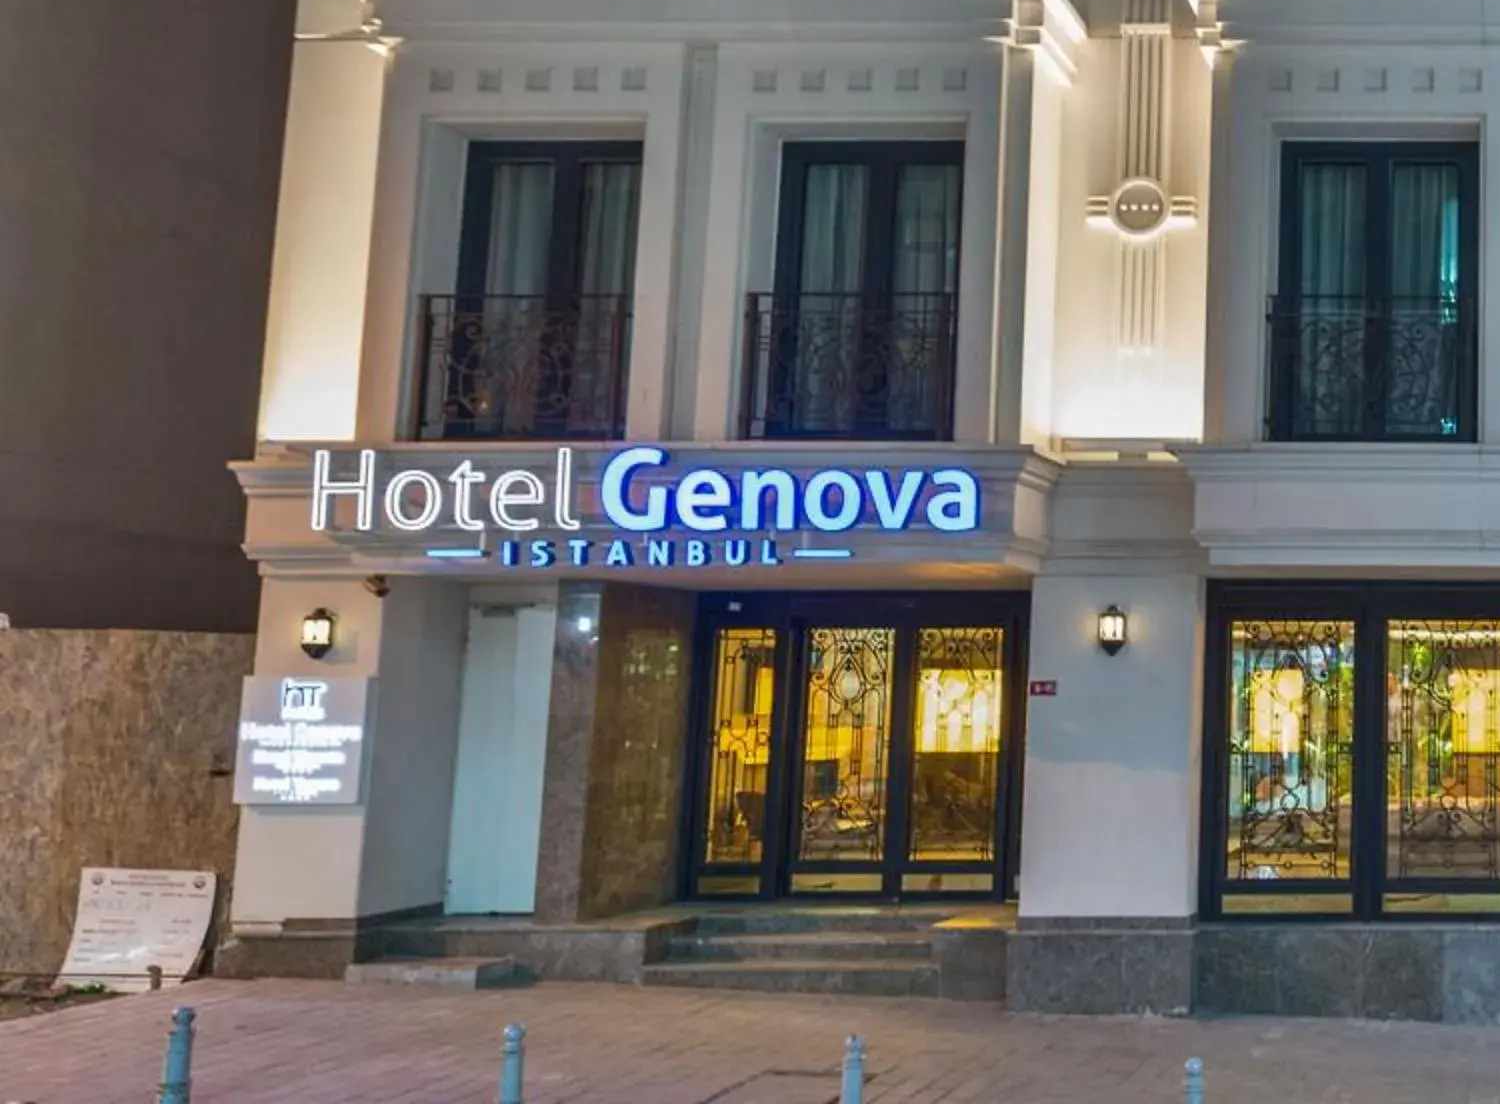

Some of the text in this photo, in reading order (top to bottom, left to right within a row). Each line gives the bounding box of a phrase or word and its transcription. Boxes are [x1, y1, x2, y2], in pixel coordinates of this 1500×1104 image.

[311, 446, 981, 533] Hotel Genova
[502, 539, 784, 567] ISTANBUL
